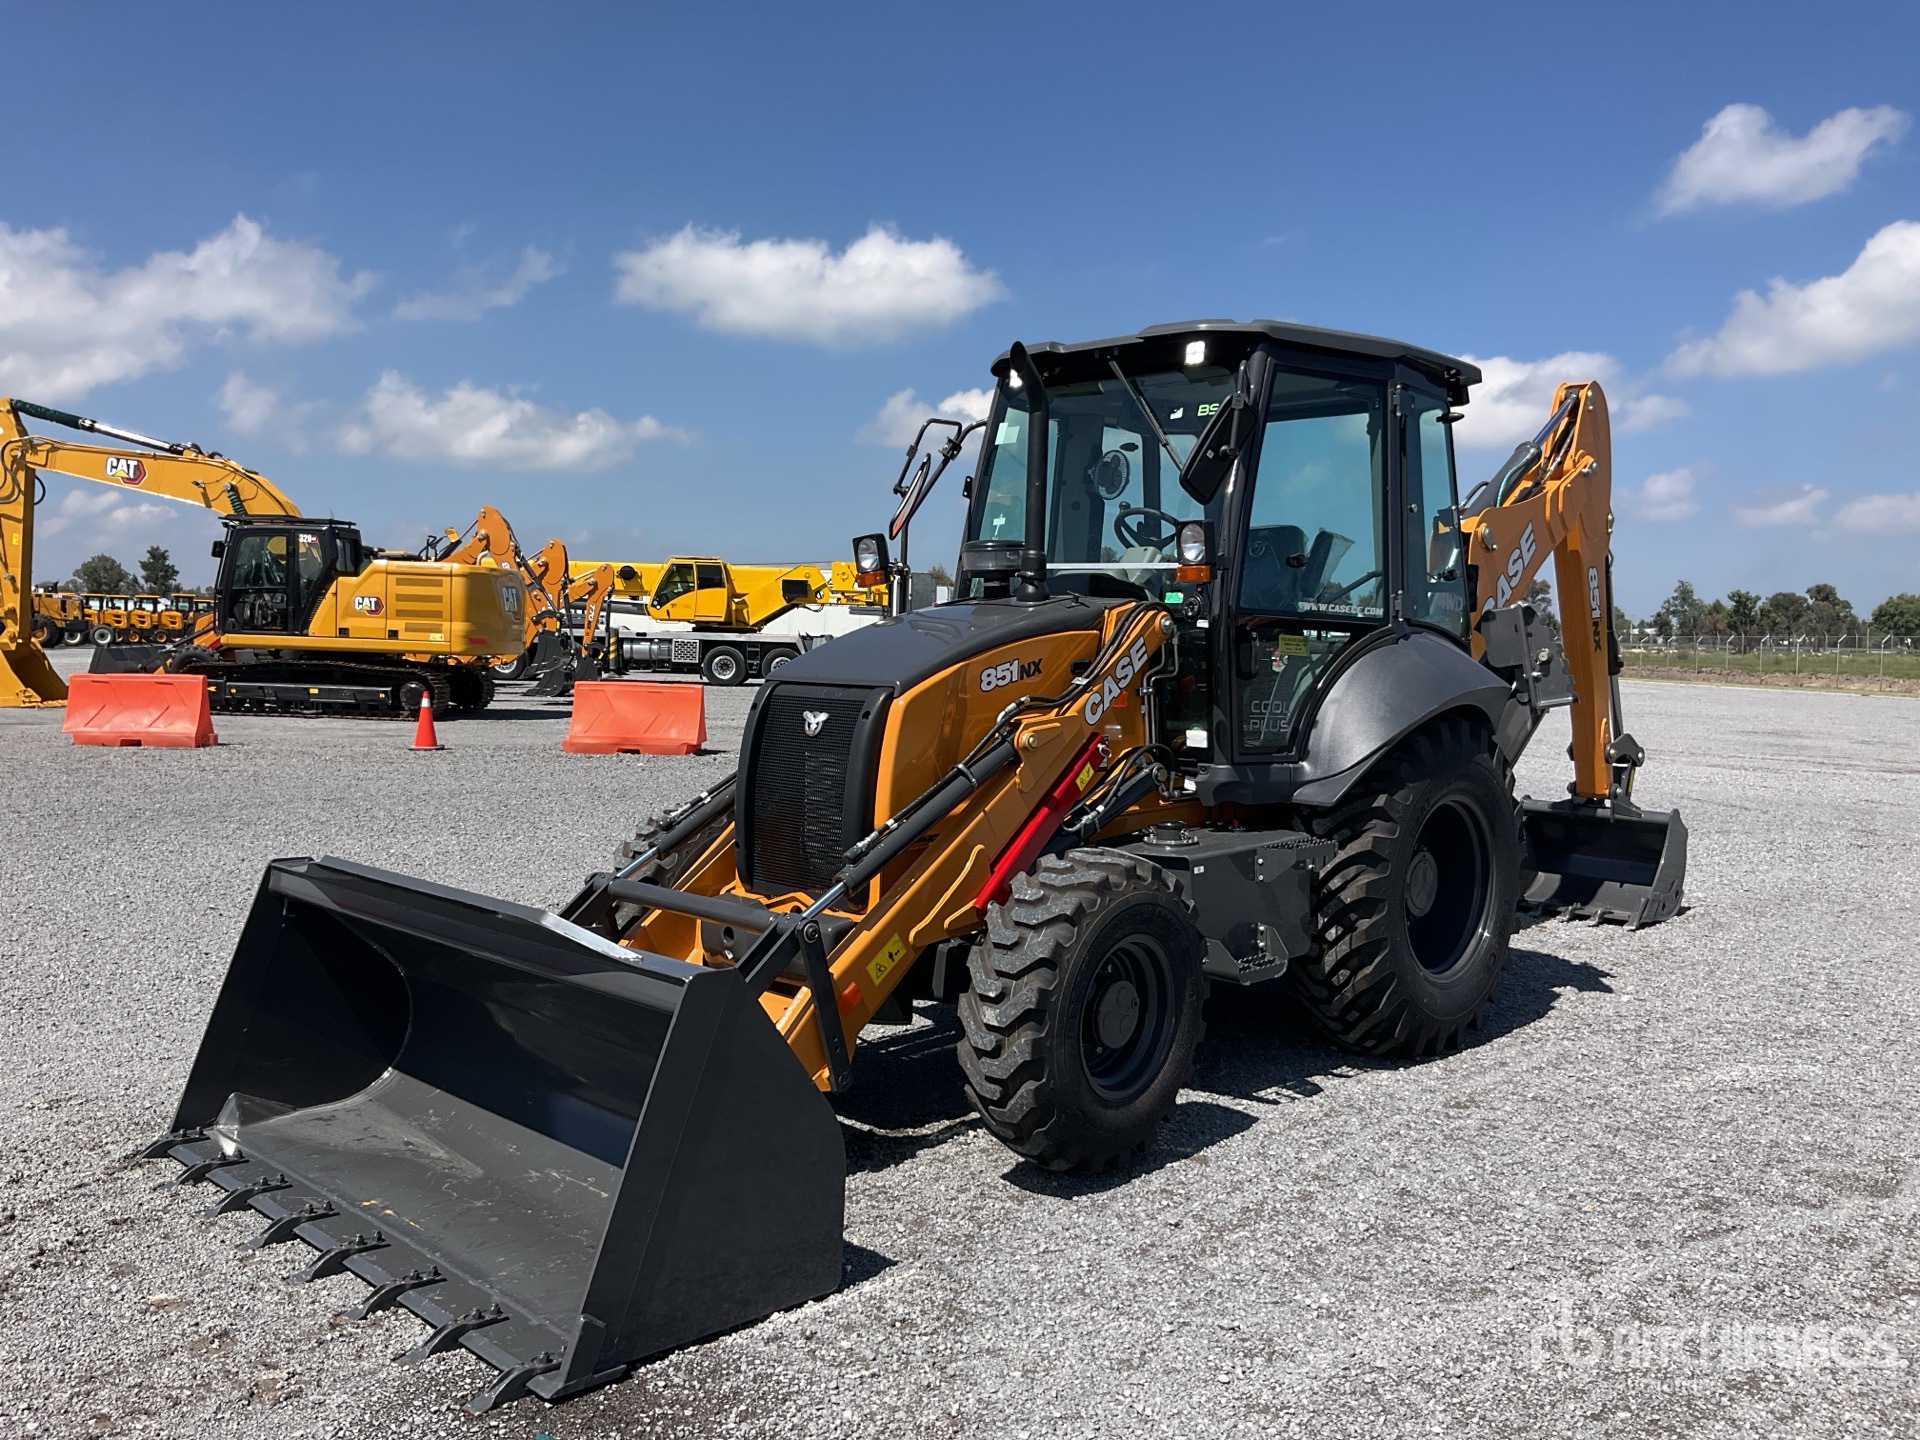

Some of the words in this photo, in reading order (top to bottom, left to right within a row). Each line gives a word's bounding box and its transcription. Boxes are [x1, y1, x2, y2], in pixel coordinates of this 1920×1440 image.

[106, 457, 138, 478] CAT
[355, 596, 377, 610] CAT
[502, 587, 517, 612] CAT
[1084, 635, 1149, 725] CASE
[1251, 700, 1289, 714] COOL
[1250, 719, 1290, 732] PLUS
